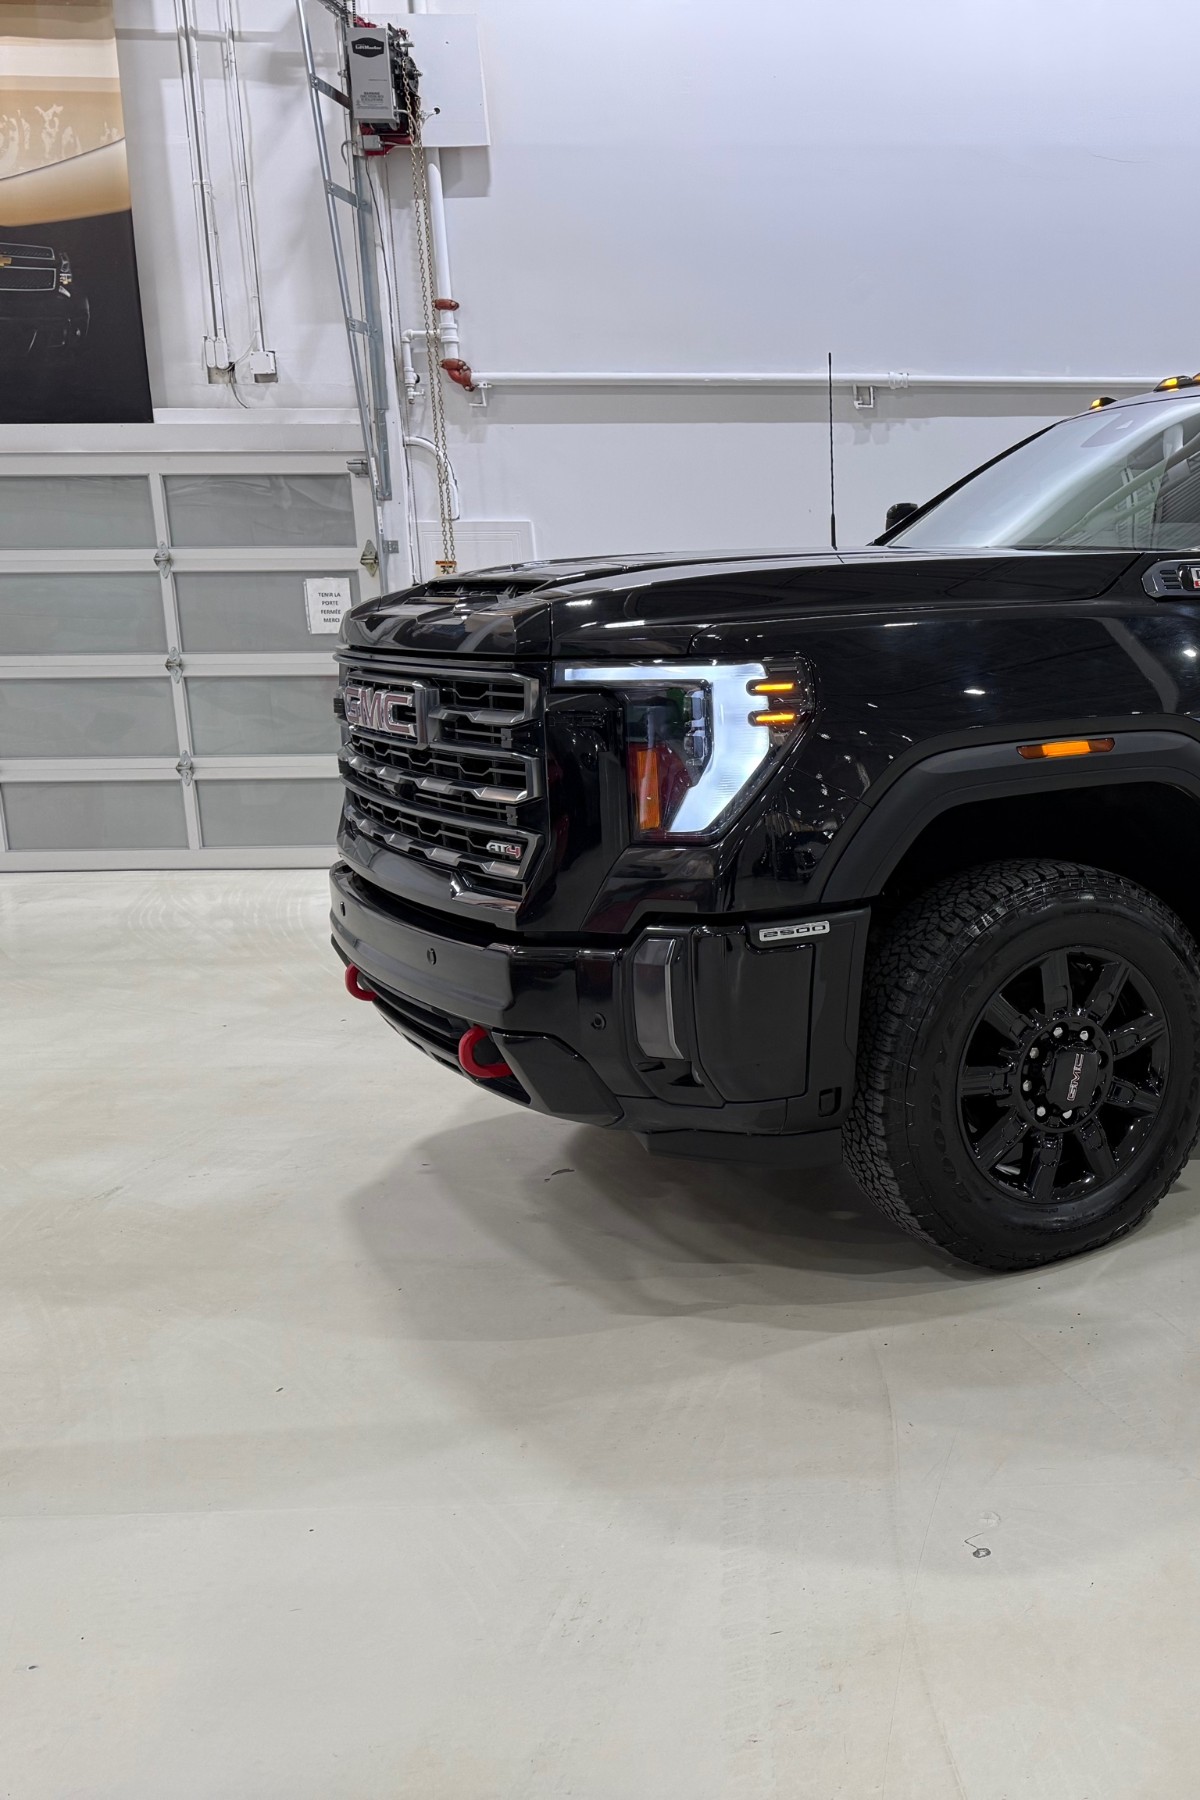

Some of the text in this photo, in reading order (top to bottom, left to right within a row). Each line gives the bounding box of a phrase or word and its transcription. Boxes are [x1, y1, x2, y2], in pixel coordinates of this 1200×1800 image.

[344, 685, 415, 737] GMC
[486, 841, 521, 859] AT4
[763, 924, 827, 939] 2500
[1067, 1053, 1084, 1101] GMC
